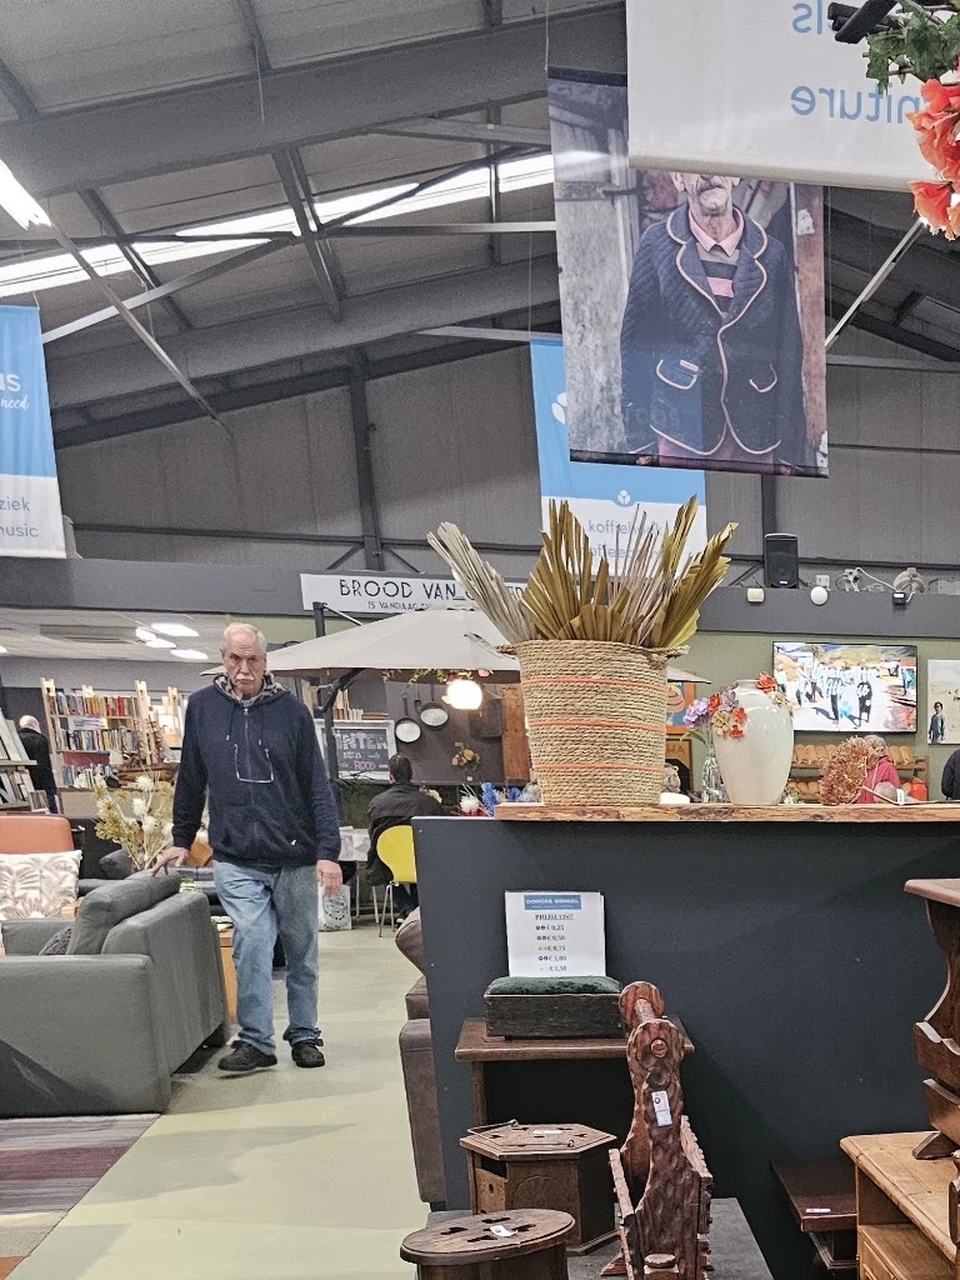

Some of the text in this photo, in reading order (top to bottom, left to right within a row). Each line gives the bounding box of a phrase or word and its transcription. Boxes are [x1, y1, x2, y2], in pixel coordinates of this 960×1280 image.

[0, 497, 30, 512] ziek
[340, 579, 413, 598] BROOD
[422, 583, 456, 600] VAN
